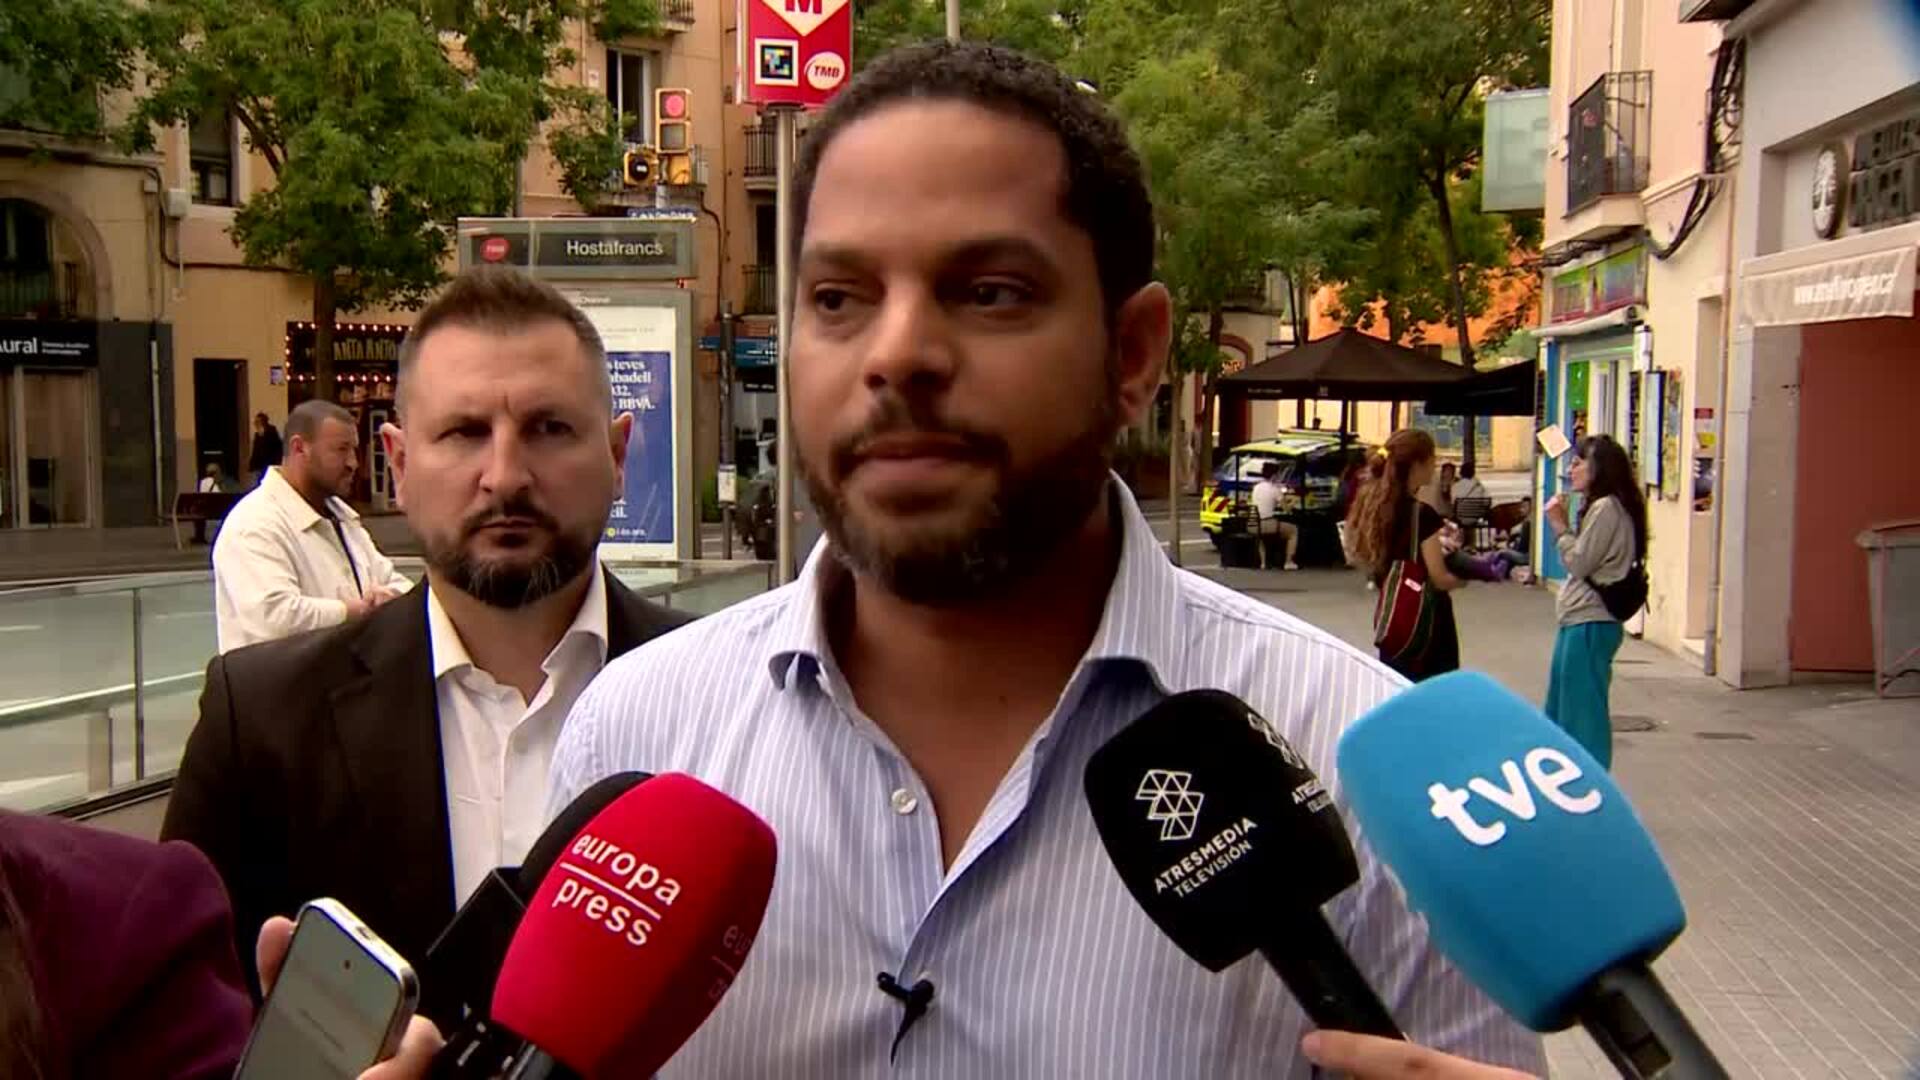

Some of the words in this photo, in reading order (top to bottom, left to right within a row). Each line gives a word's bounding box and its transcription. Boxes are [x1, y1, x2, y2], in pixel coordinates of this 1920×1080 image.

[813, 65, 840, 78] TMB
[566, 239, 664, 256] Hostafrancs
[1427, 746, 1603, 846] tve
[571, 834, 682, 906] europa
[1154, 816, 1258, 894] ATRESMEDIA
[1172, 839, 1253, 898] TELEVISIÓN
[551, 878, 653, 946] press
